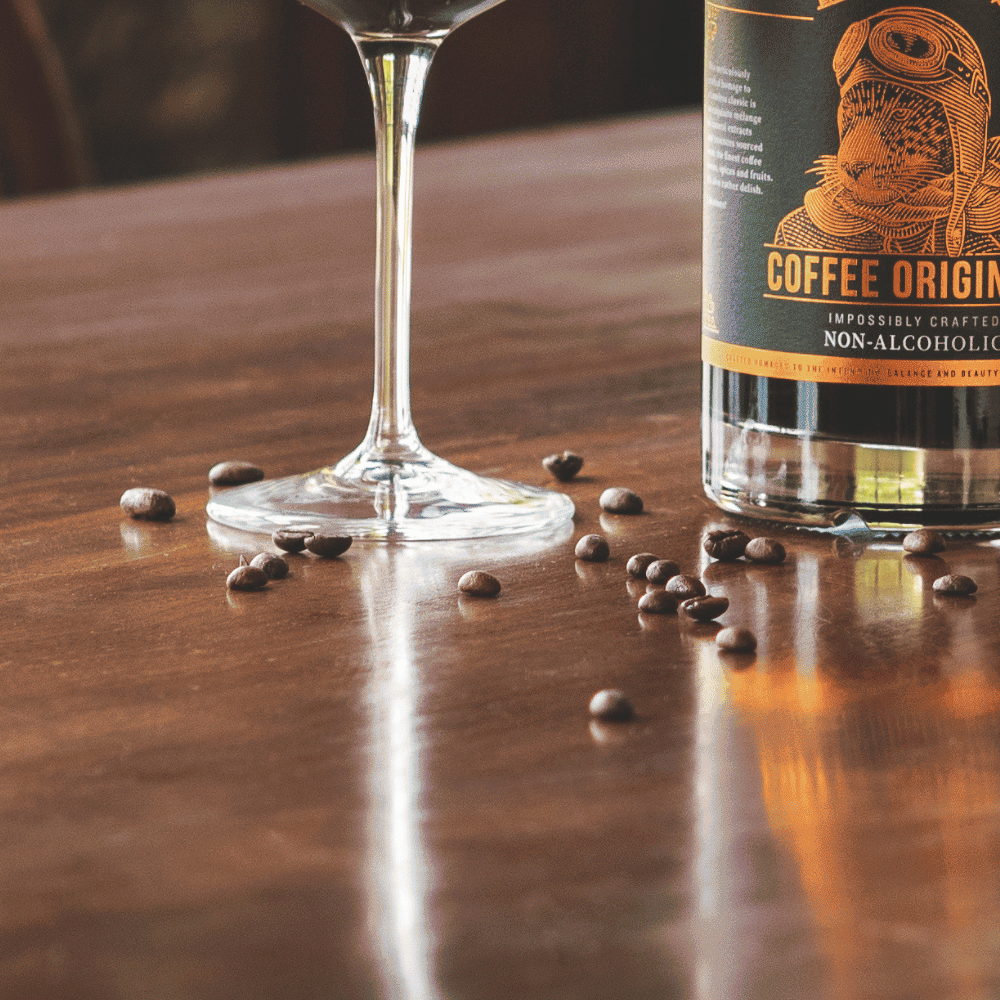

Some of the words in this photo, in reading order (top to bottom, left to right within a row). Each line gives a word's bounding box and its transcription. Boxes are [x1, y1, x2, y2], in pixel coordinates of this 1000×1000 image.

[767, 251, 879, 298] COFFEE
[828, 312, 922, 328] IMPOSSIBLY
[930, 315, 999, 328] CRAFTED
[793, 363, 803, 372] TO
[807, 364, 822, 373] THE
[887, 368, 932, 379] BALANCE
[937, 369, 956, 378] AND
[961, 368, 999, 378] BEAUTY
